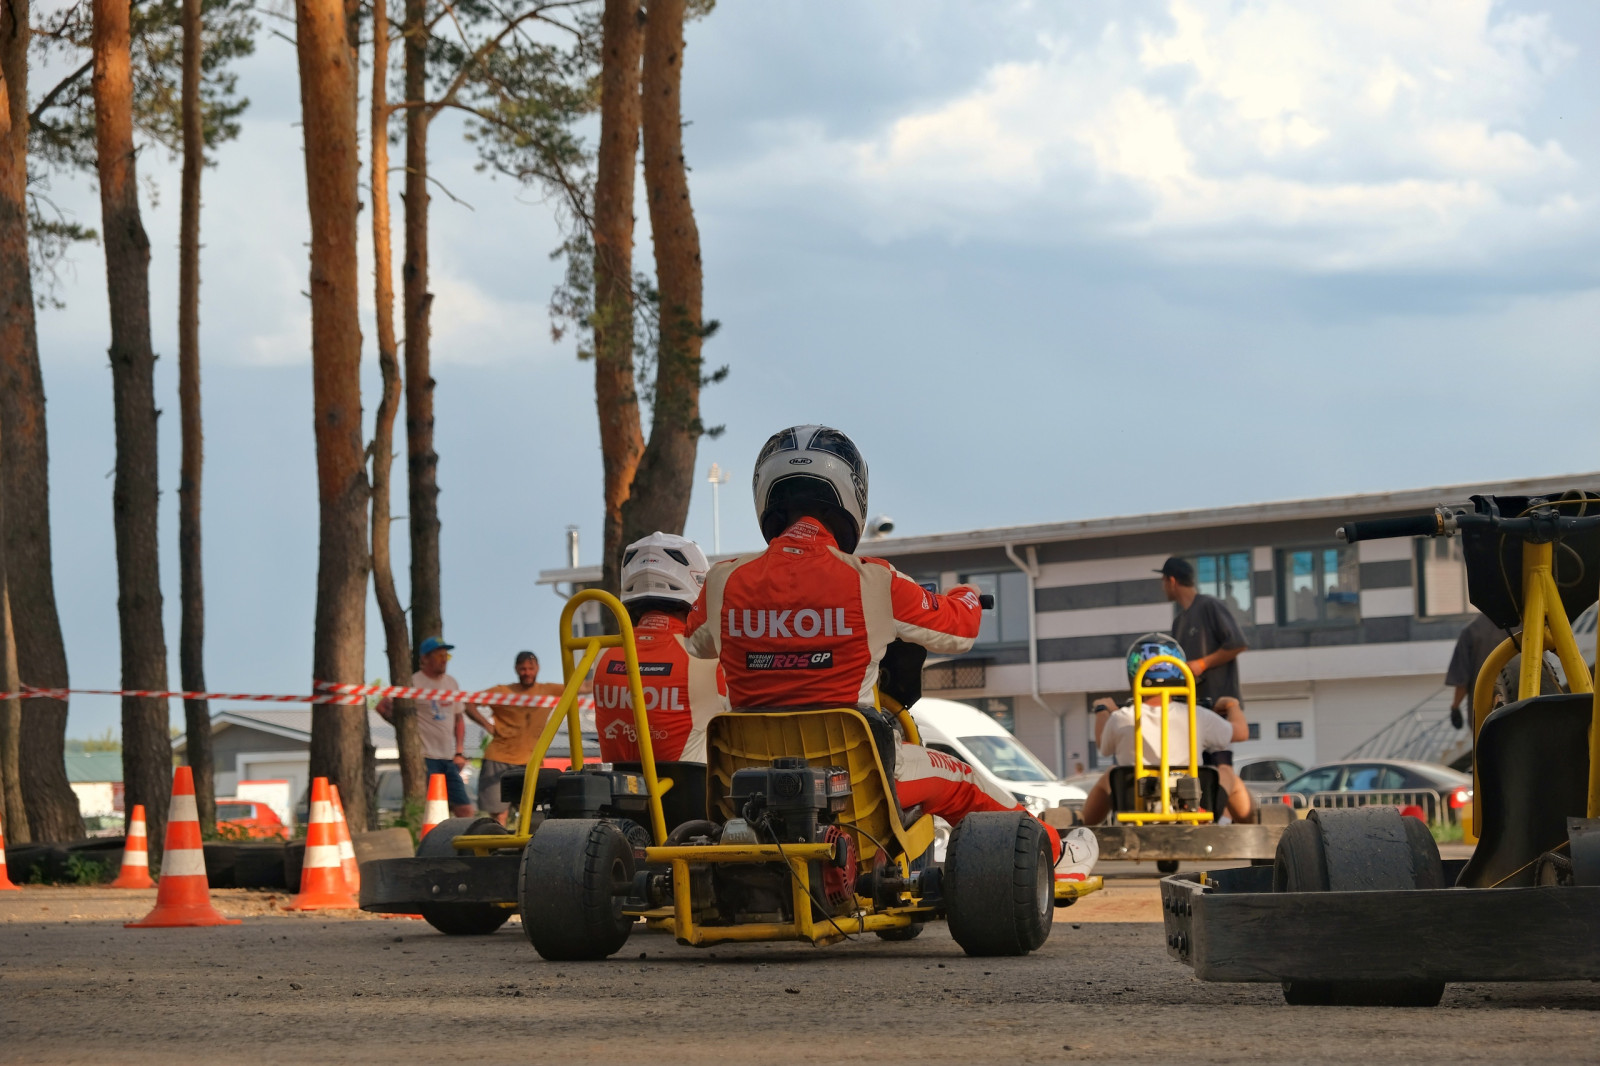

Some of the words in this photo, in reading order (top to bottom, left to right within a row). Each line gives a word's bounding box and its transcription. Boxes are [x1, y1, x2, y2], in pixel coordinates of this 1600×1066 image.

[728, 607, 853, 639] LUKOIL
[772, 654, 812, 668] RDS
[811, 653, 831, 663] GP
[595, 684, 685, 711] LUKOIL
